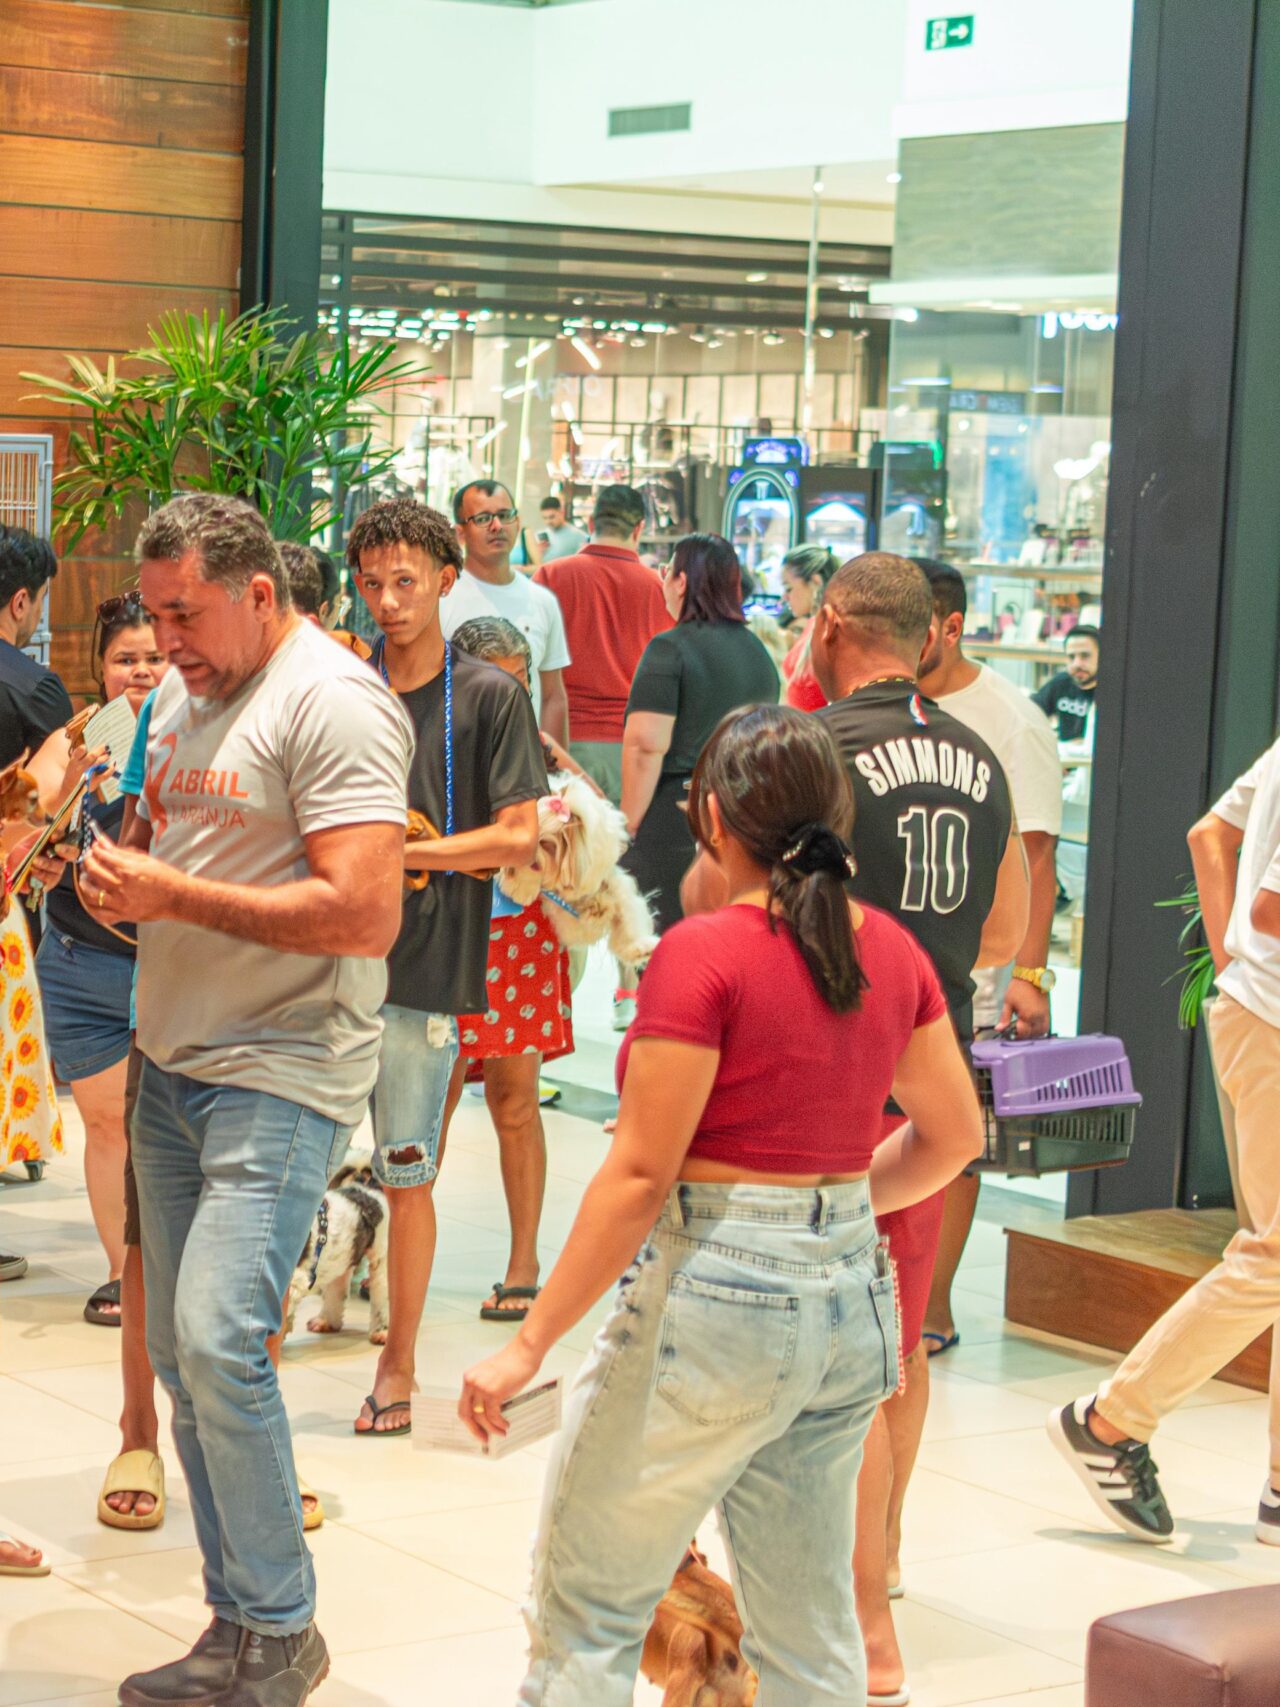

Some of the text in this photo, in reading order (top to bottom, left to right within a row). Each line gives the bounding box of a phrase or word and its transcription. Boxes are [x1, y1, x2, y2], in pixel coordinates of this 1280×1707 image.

[168, 768, 249, 799] ABRIL
[854, 737, 991, 803] SIMMONS
[897, 805, 969, 915] 10
